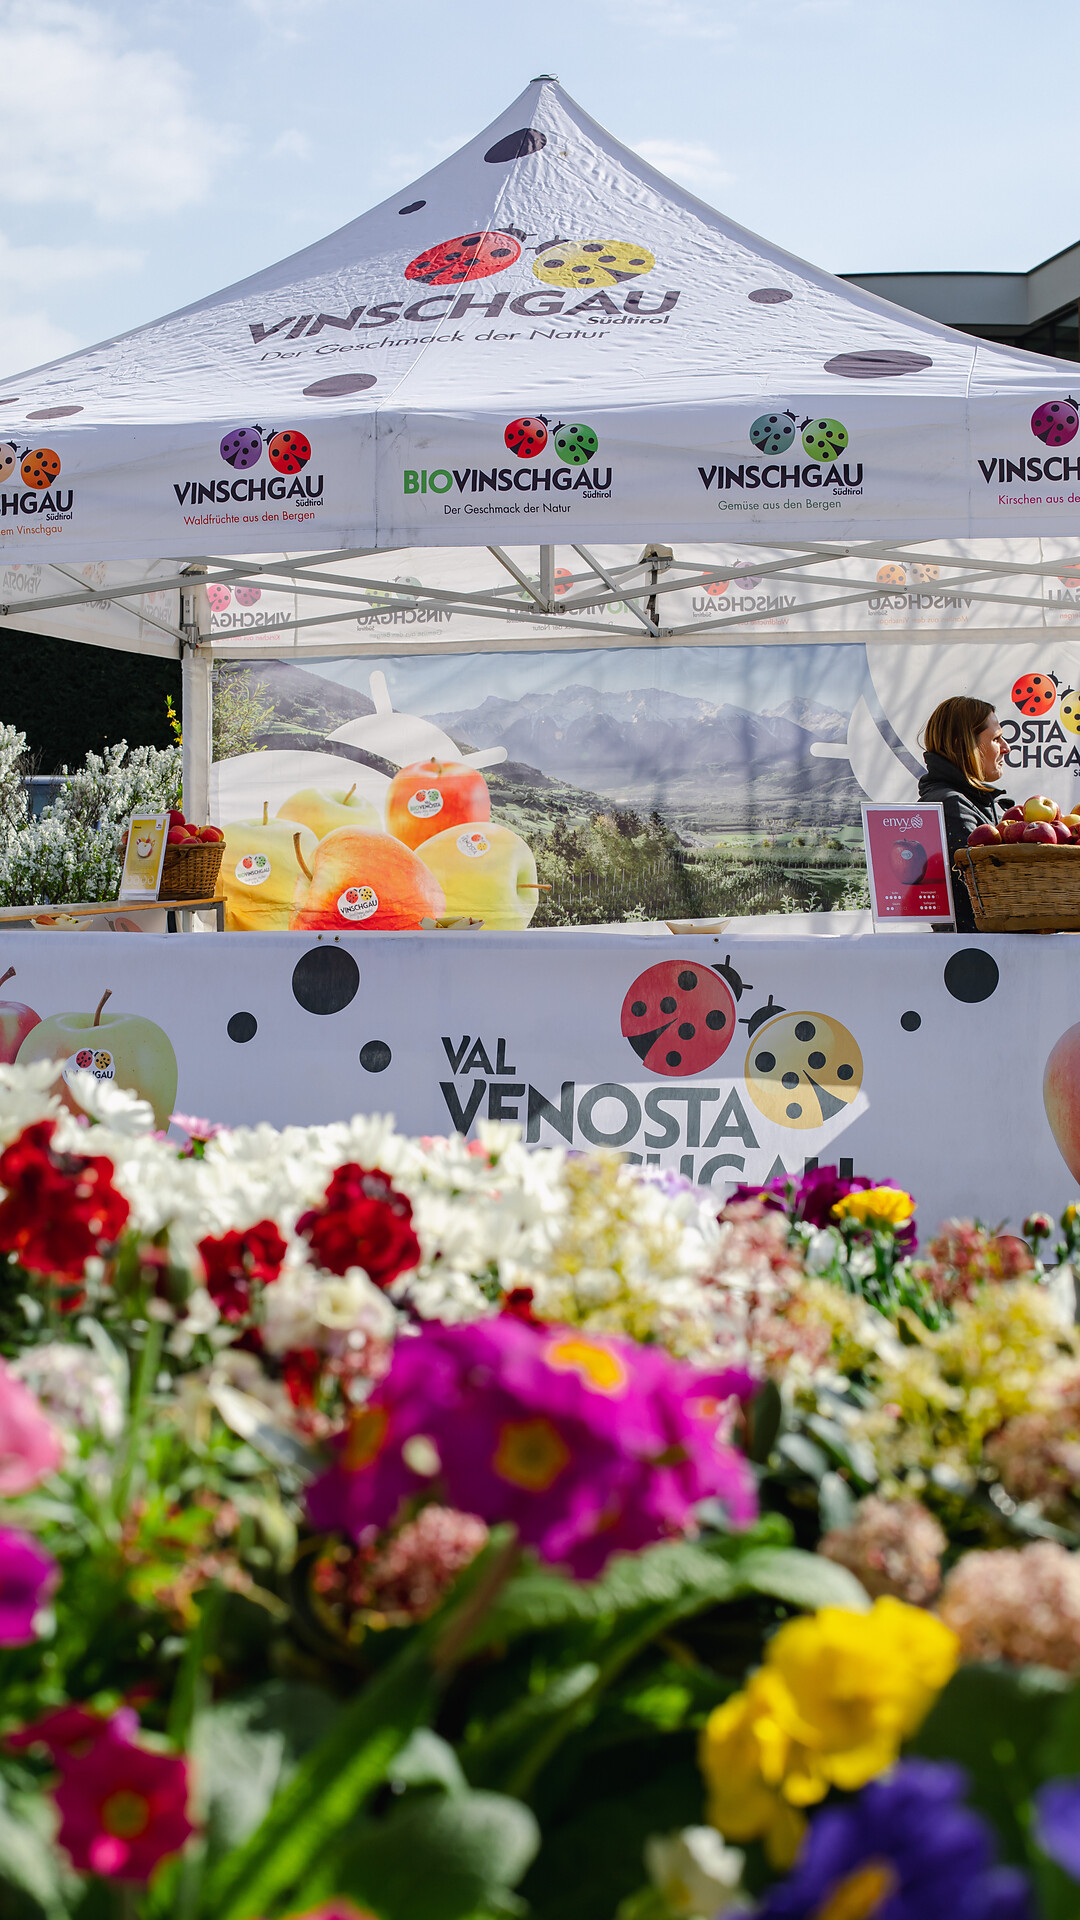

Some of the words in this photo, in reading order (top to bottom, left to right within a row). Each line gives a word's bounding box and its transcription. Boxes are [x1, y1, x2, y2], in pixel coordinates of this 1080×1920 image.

[249, 290, 681, 344] VINSCHGAU
[587, 316, 669, 325] Südtirol
[260, 351, 308, 361] Der
[315, 331, 466, 354] Geschmack
[475, 330, 521, 341] der
[529, 329, 611, 340] Natur
[698, 463, 864, 491] VINSCHGAU
[977, 456, 1080, 484] VINSCH
[403, 468, 612, 494] BIOVINSCHGAU
[173, 475, 324, 506] VINSCHGAU
[583, 490, 612, 499] Südtirol
[832, 487, 863, 496] Südtirol
[0, 490, 74, 516] HGAU
[295, 498, 324, 507] Südtirol
[718, 500, 760, 511] Gemüse
[762, 502, 780, 510] aus
[783, 499, 802, 509] den
[806, 499, 842, 511] Bergen
[998, 493, 1042, 505] Kirschen
[46, 512, 73, 521] Südtirol
[444, 504, 461, 515] Der
[464, 502, 521, 514] Geschmack
[523, 502, 540, 513] der
[543, 502, 571, 513] Natur
[183, 513, 240, 526] Waldfrüchte
[242, 514, 259, 523] aus
[261, 511, 280, 522] den
[282, 510, 316, 523] Bergen
[16, 523, 63, 536] Vinschgau
[883, 817, 912, 833] envy
[340, 899, 378, 914] VINSCHGAU
[441, 1035, 517, 1076] VAL
[439, 1079, 761, 1150] VENOSTA
